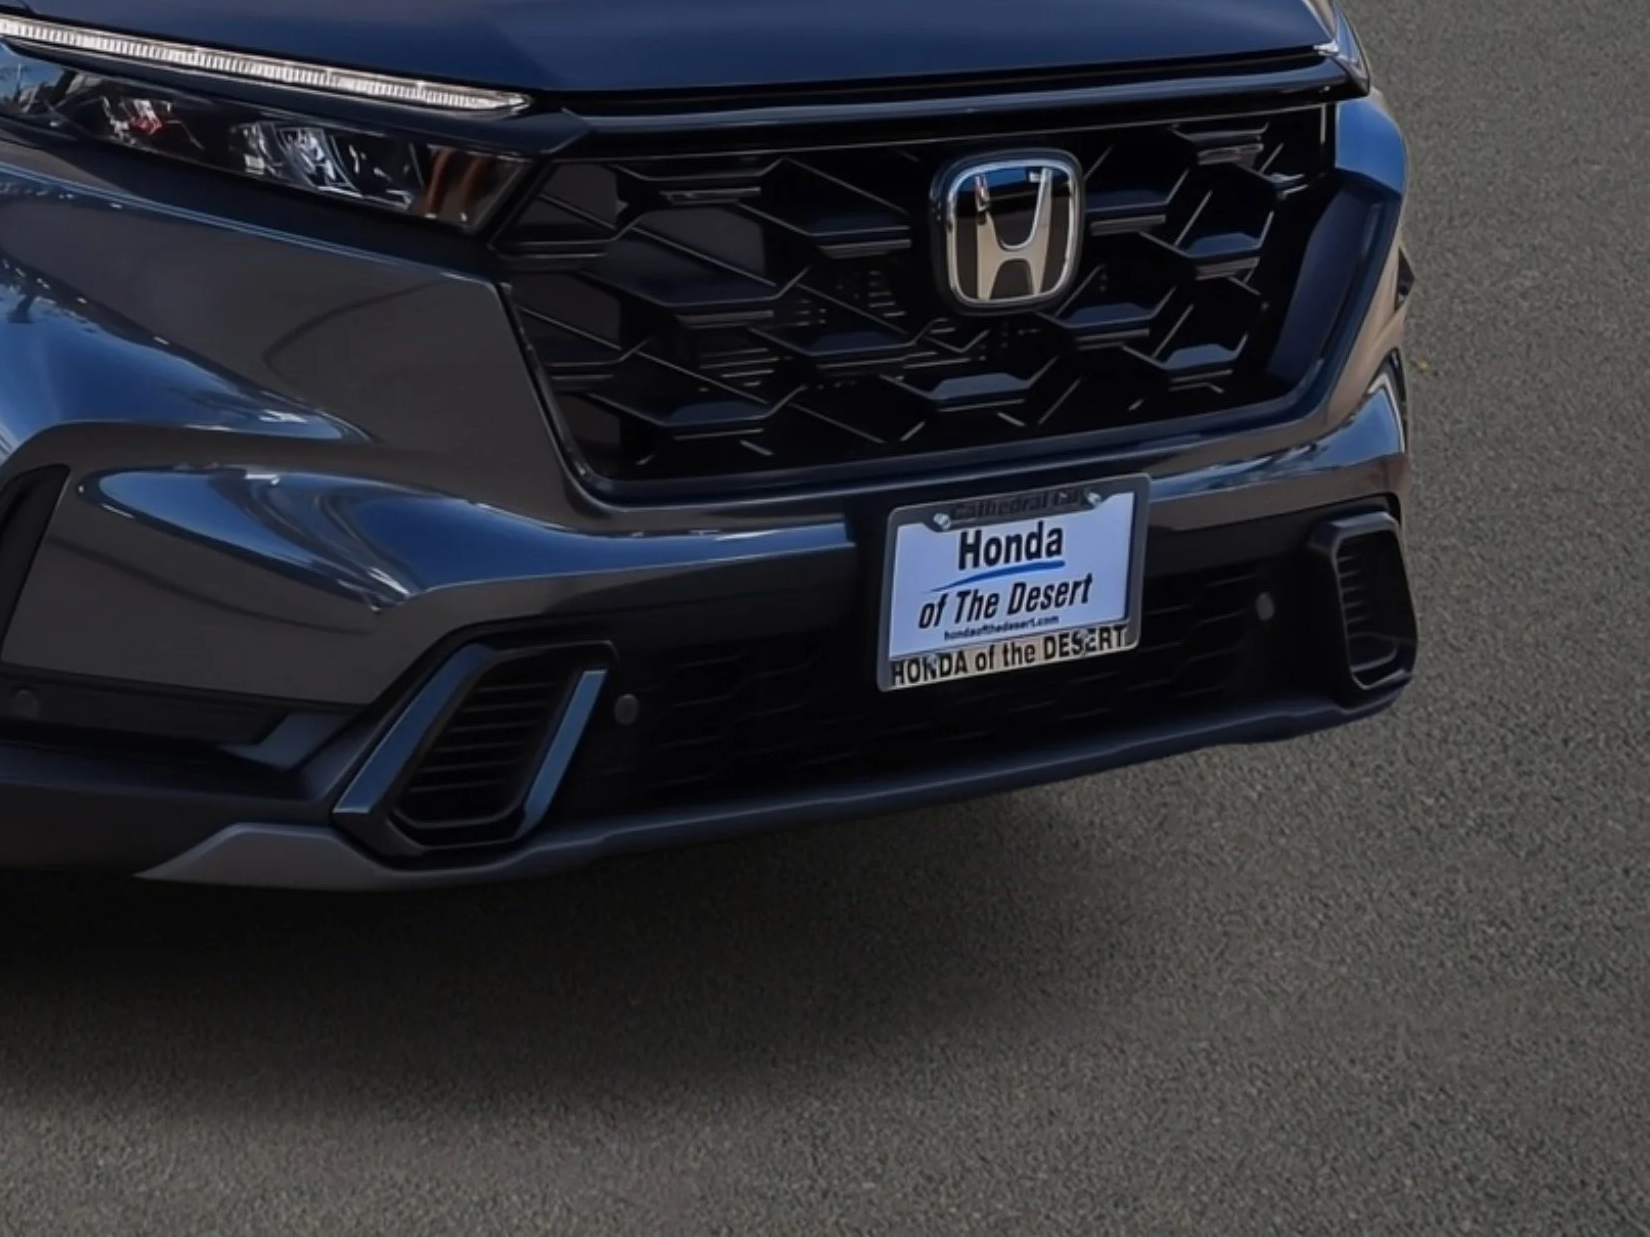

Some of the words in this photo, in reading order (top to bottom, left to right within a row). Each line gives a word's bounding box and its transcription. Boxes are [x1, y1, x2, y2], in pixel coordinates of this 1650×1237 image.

[958, 520, 1063, 571] Honda
[918, 593, 949, 629] of
[955, 588, 1000, 624] The
[1007, 572, 1093, 614] Desert
[891, 651, 968, 686] HONDA
[975, 644, 997, 672] of
[1003, 640, 1036, 667] the
[1043, 624, 1128, 660] DESERT
